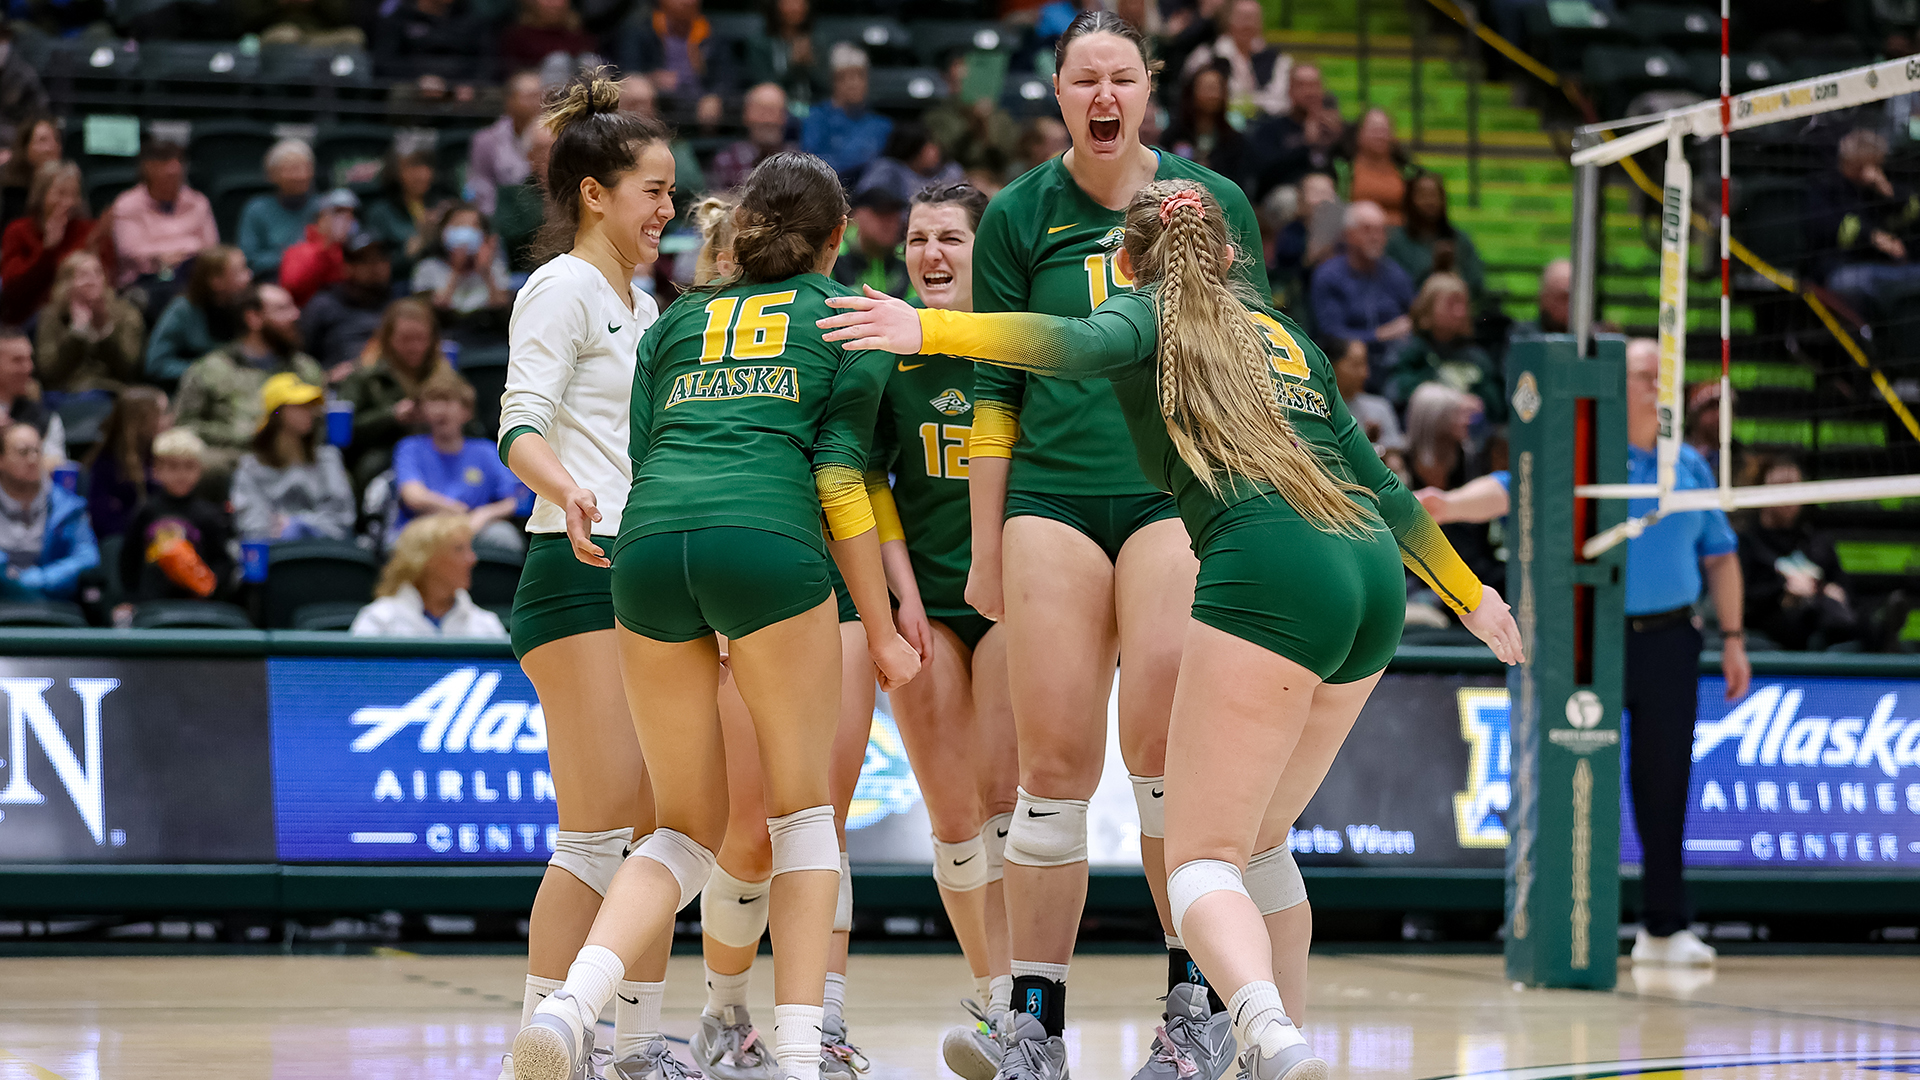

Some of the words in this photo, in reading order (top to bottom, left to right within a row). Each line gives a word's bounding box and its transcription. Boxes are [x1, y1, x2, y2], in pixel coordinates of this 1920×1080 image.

[699, 289, 798, 365] 16
[1249, 312, 1312, 381] 3
[664, 366, 800, 411] ALASKA
[919, 421, 973, 480] 12
[349, 666, 547, 753] Alas
[371, 767, 557, 803] AIRLIN
[426, 822, 560, 853] CENT
[1751, 831, 1899, 861] CENTER
